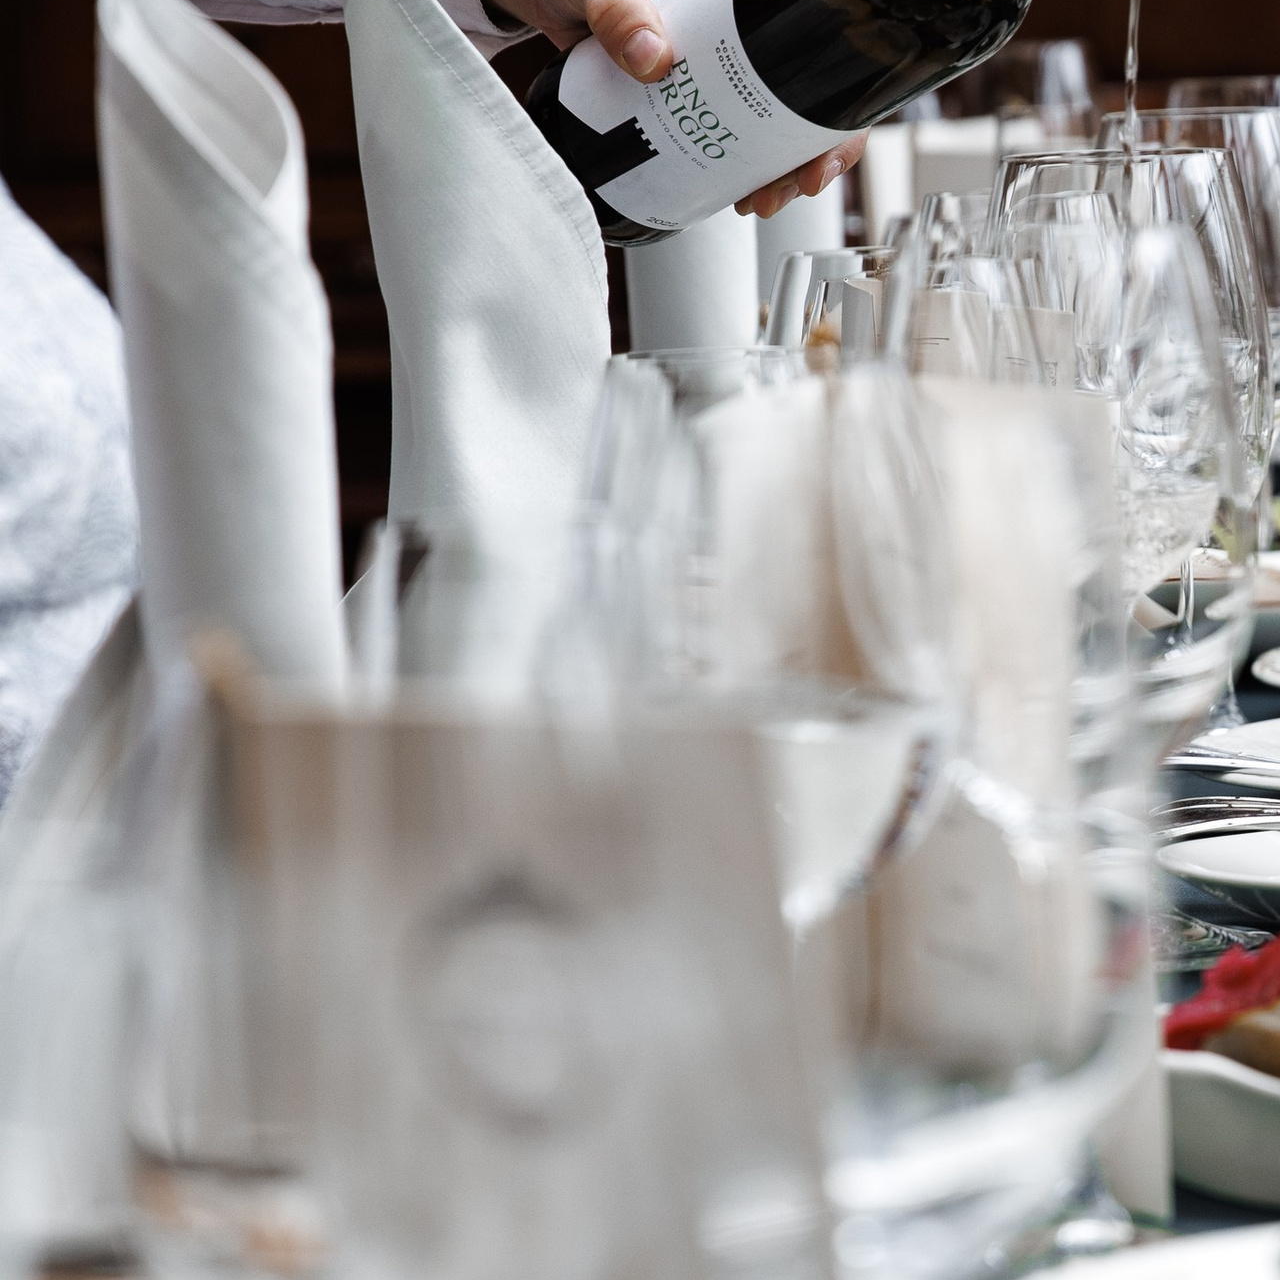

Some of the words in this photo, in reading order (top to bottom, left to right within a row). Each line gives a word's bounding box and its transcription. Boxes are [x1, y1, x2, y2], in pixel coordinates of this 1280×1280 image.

[671, 55, 739, 144] PINOT
[715, 46, 764, 118] COLTERENZIO
[720, 38, 773, 118] SCHRECKBICHL
[643, 83, 656, 110] TIROL
[691, 157, 708, 170] DOC
